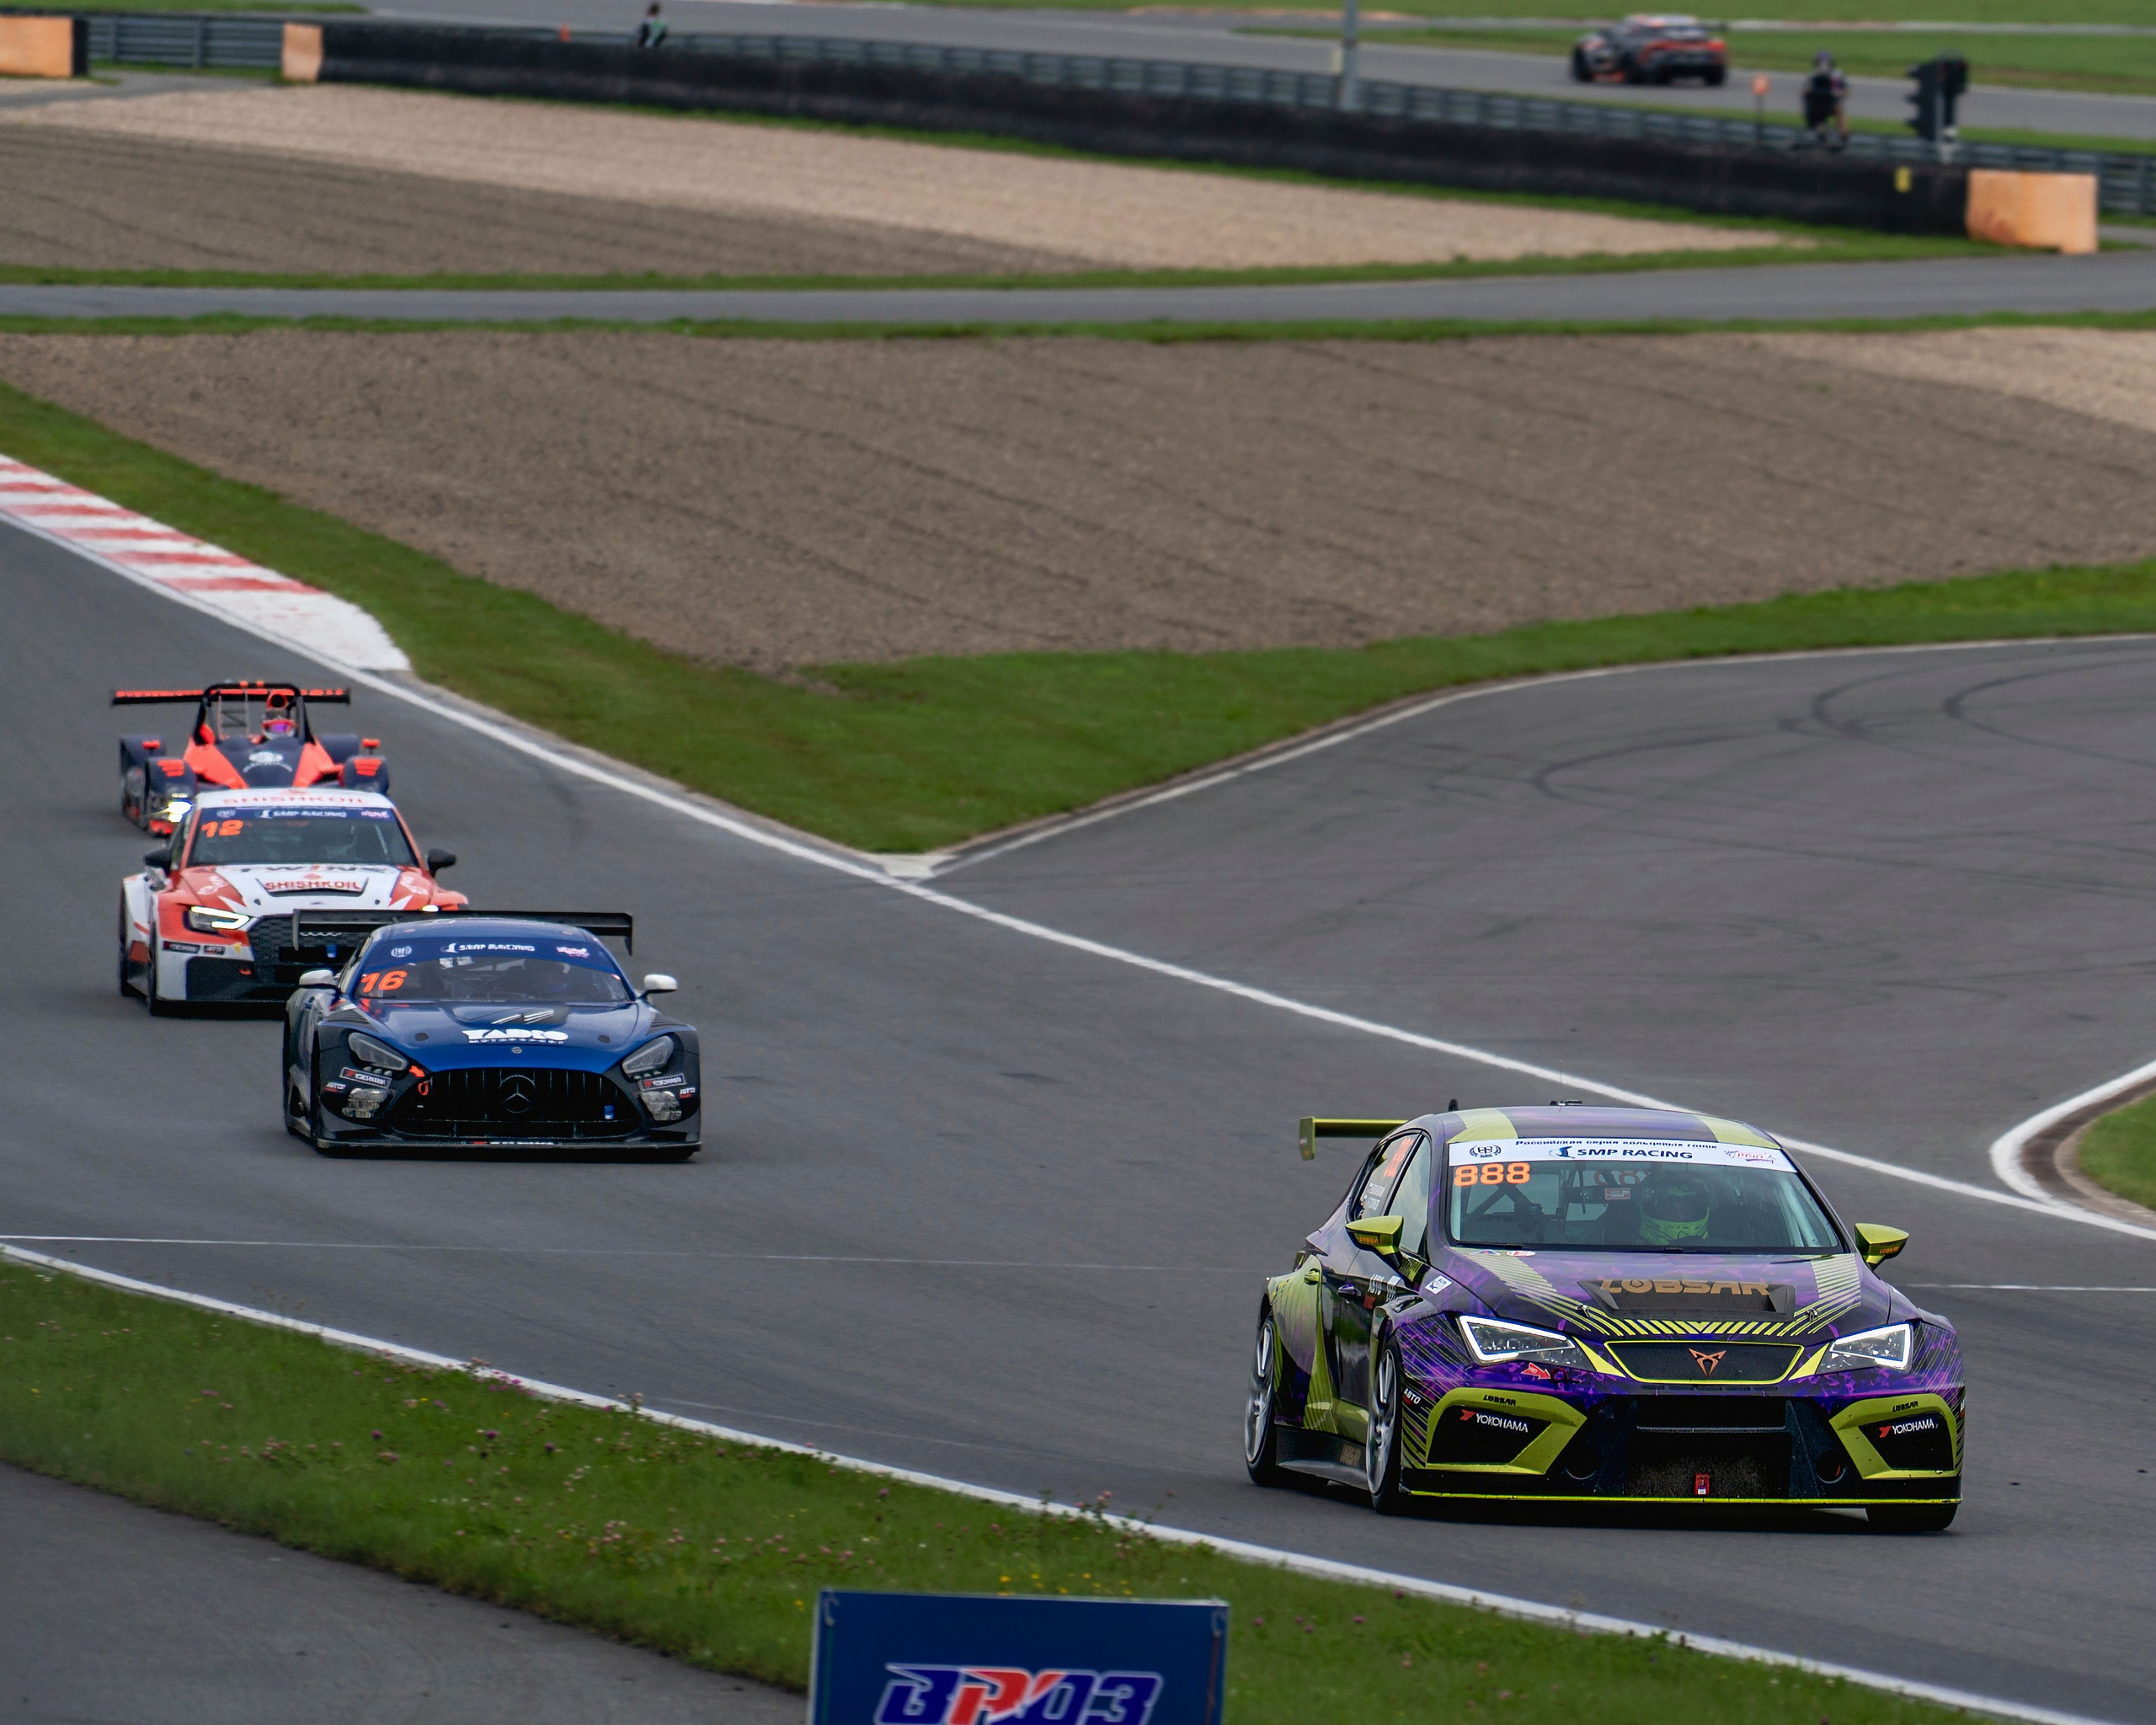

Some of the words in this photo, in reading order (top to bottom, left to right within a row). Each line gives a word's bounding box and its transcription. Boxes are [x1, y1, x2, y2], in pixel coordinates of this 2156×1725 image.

[200, 819, 244, 838] 12
[264, 879, 361, 890] SHISHKOIL
[360, 970, 408, 992] 16
[1577, 1148, 1619, 1156] SMP
[1622, 1148, 1693, 1160] RACING
[1454, 1162, 1531, 1188] 888
[1476, 1413, 1529, 1433] YOKOHAMA
[1892, 1418, 1935, 1435] YOKOHAMA
